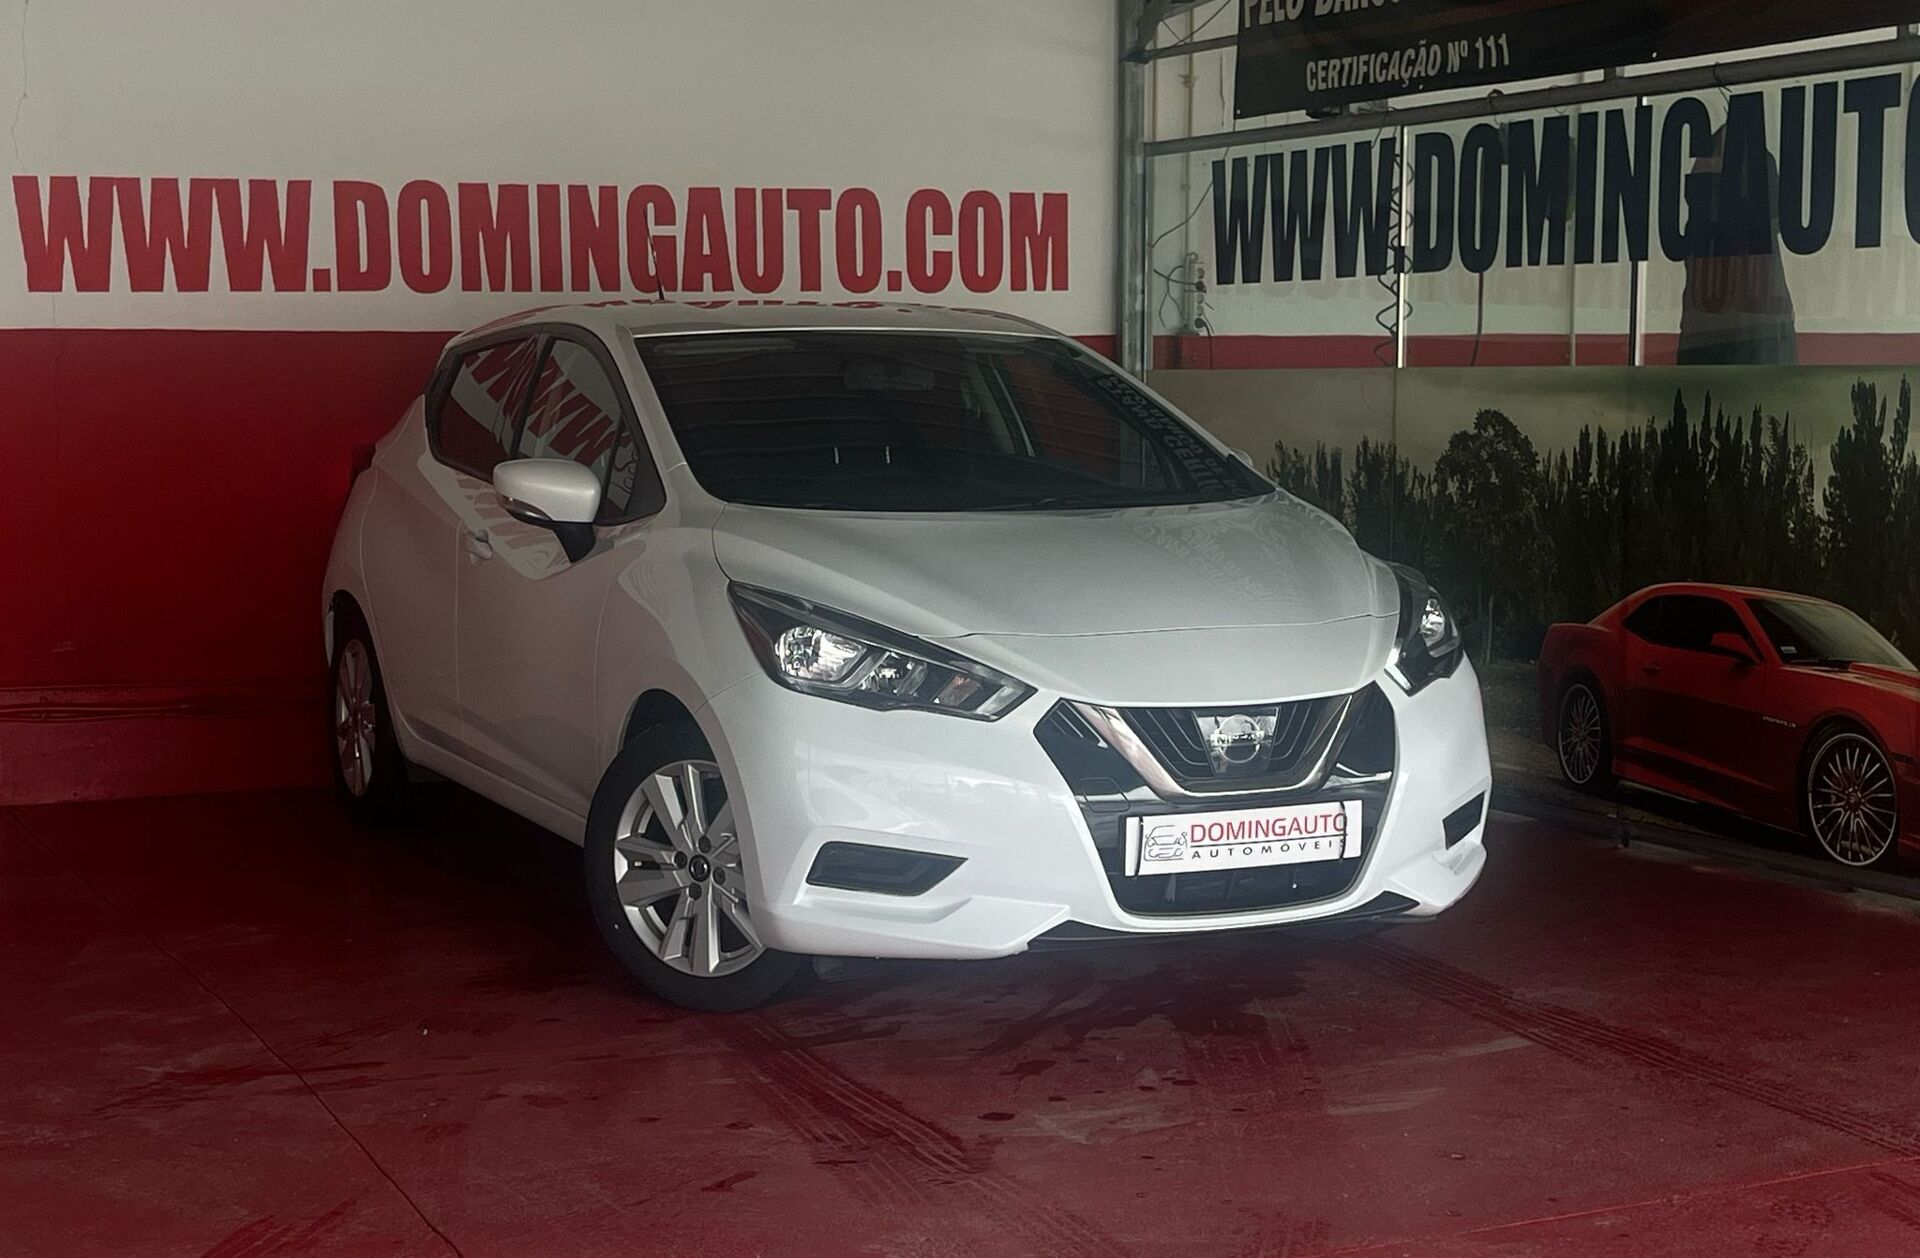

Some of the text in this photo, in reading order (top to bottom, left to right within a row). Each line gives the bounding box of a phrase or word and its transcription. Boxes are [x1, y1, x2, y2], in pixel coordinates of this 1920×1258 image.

[1305, 39, 1442, 92] CERTIFICAÇÃO
[1474, 32, 1510, 70] 111
[1211, 72, 1920, 286] WWW.DOMINGAUT
[12, 175, 1069, 294] WWW.DOMINGAUTO.COM
[1190, 812, 1348, 843] DOMINGAUTO
